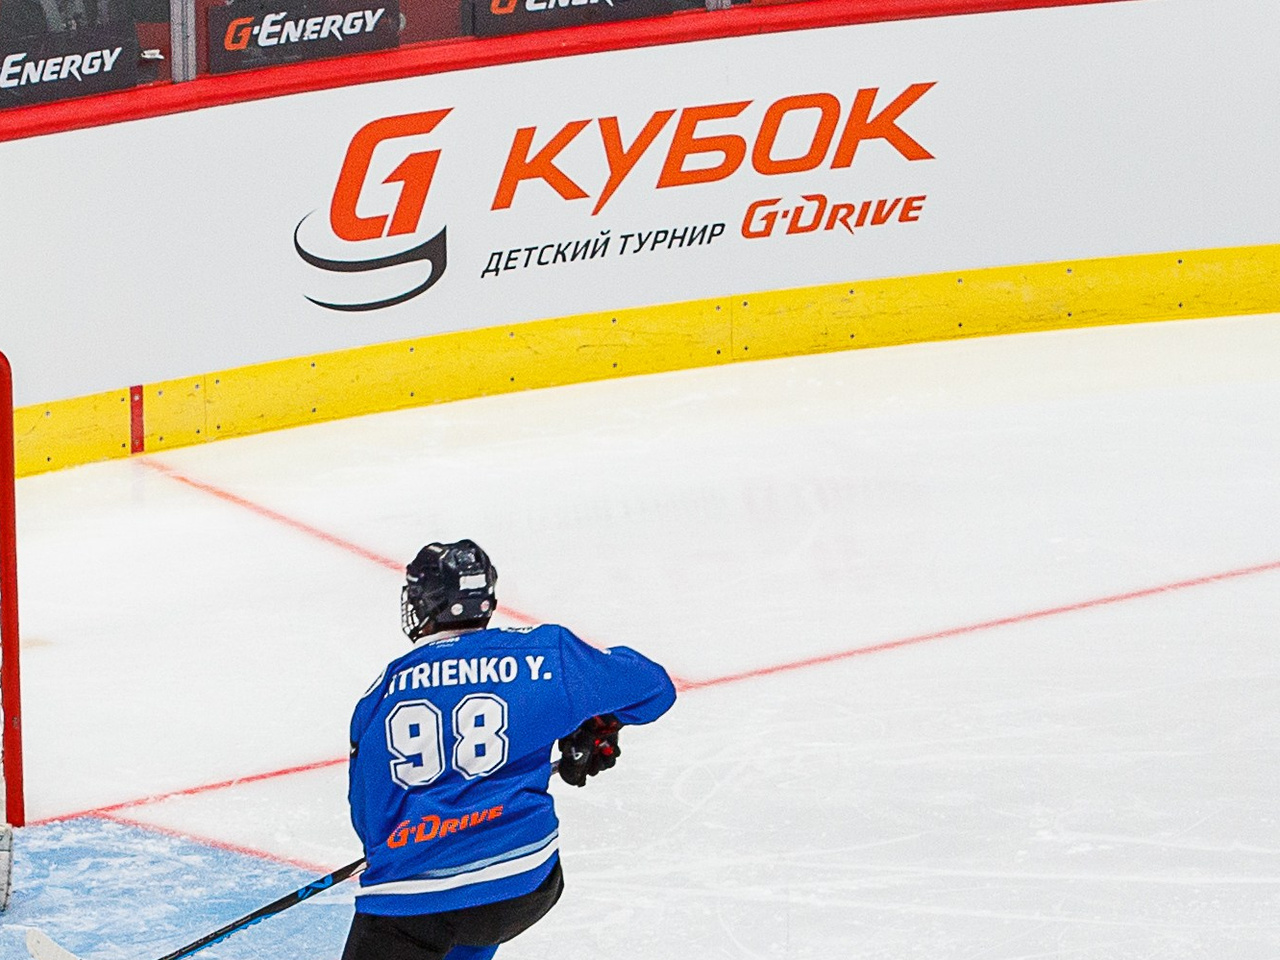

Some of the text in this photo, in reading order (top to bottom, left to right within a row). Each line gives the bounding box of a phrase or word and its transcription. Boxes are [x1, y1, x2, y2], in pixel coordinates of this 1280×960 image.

[490, 81, 939, 217] КУБОК
[480, 230, 610, 279] ДЕТСКИЙ
[619, 222, 726, 256] ТУРНИР
[525, 655, 553, 681] Y.
[384, 693, 509, 790] 98
